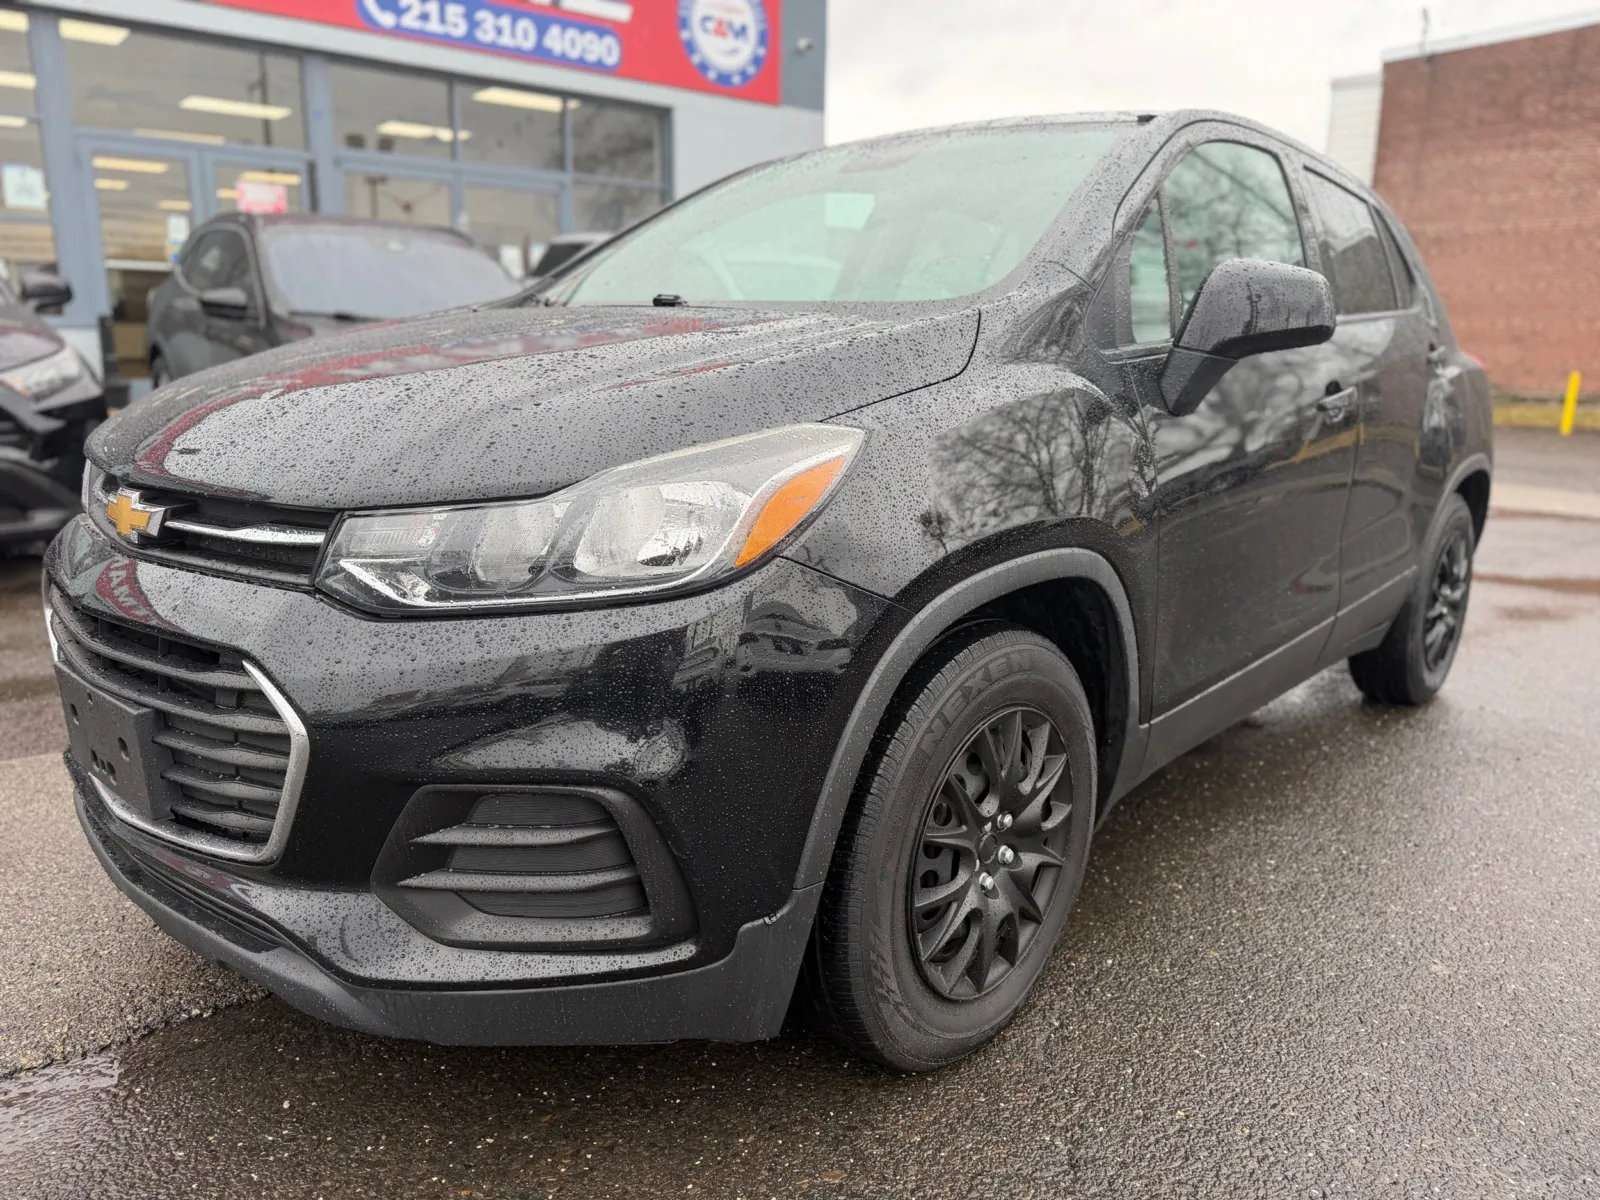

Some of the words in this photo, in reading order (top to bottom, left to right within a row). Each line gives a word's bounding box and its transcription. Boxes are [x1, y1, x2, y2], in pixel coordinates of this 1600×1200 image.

[398, 0, 468, 38] 215
[474, 9, 538, 51] 310
[542, 23, 621, 66] 4090
[700, 14, 748, 41] C&M
[920, 651, 1031, 754] NEXEN
